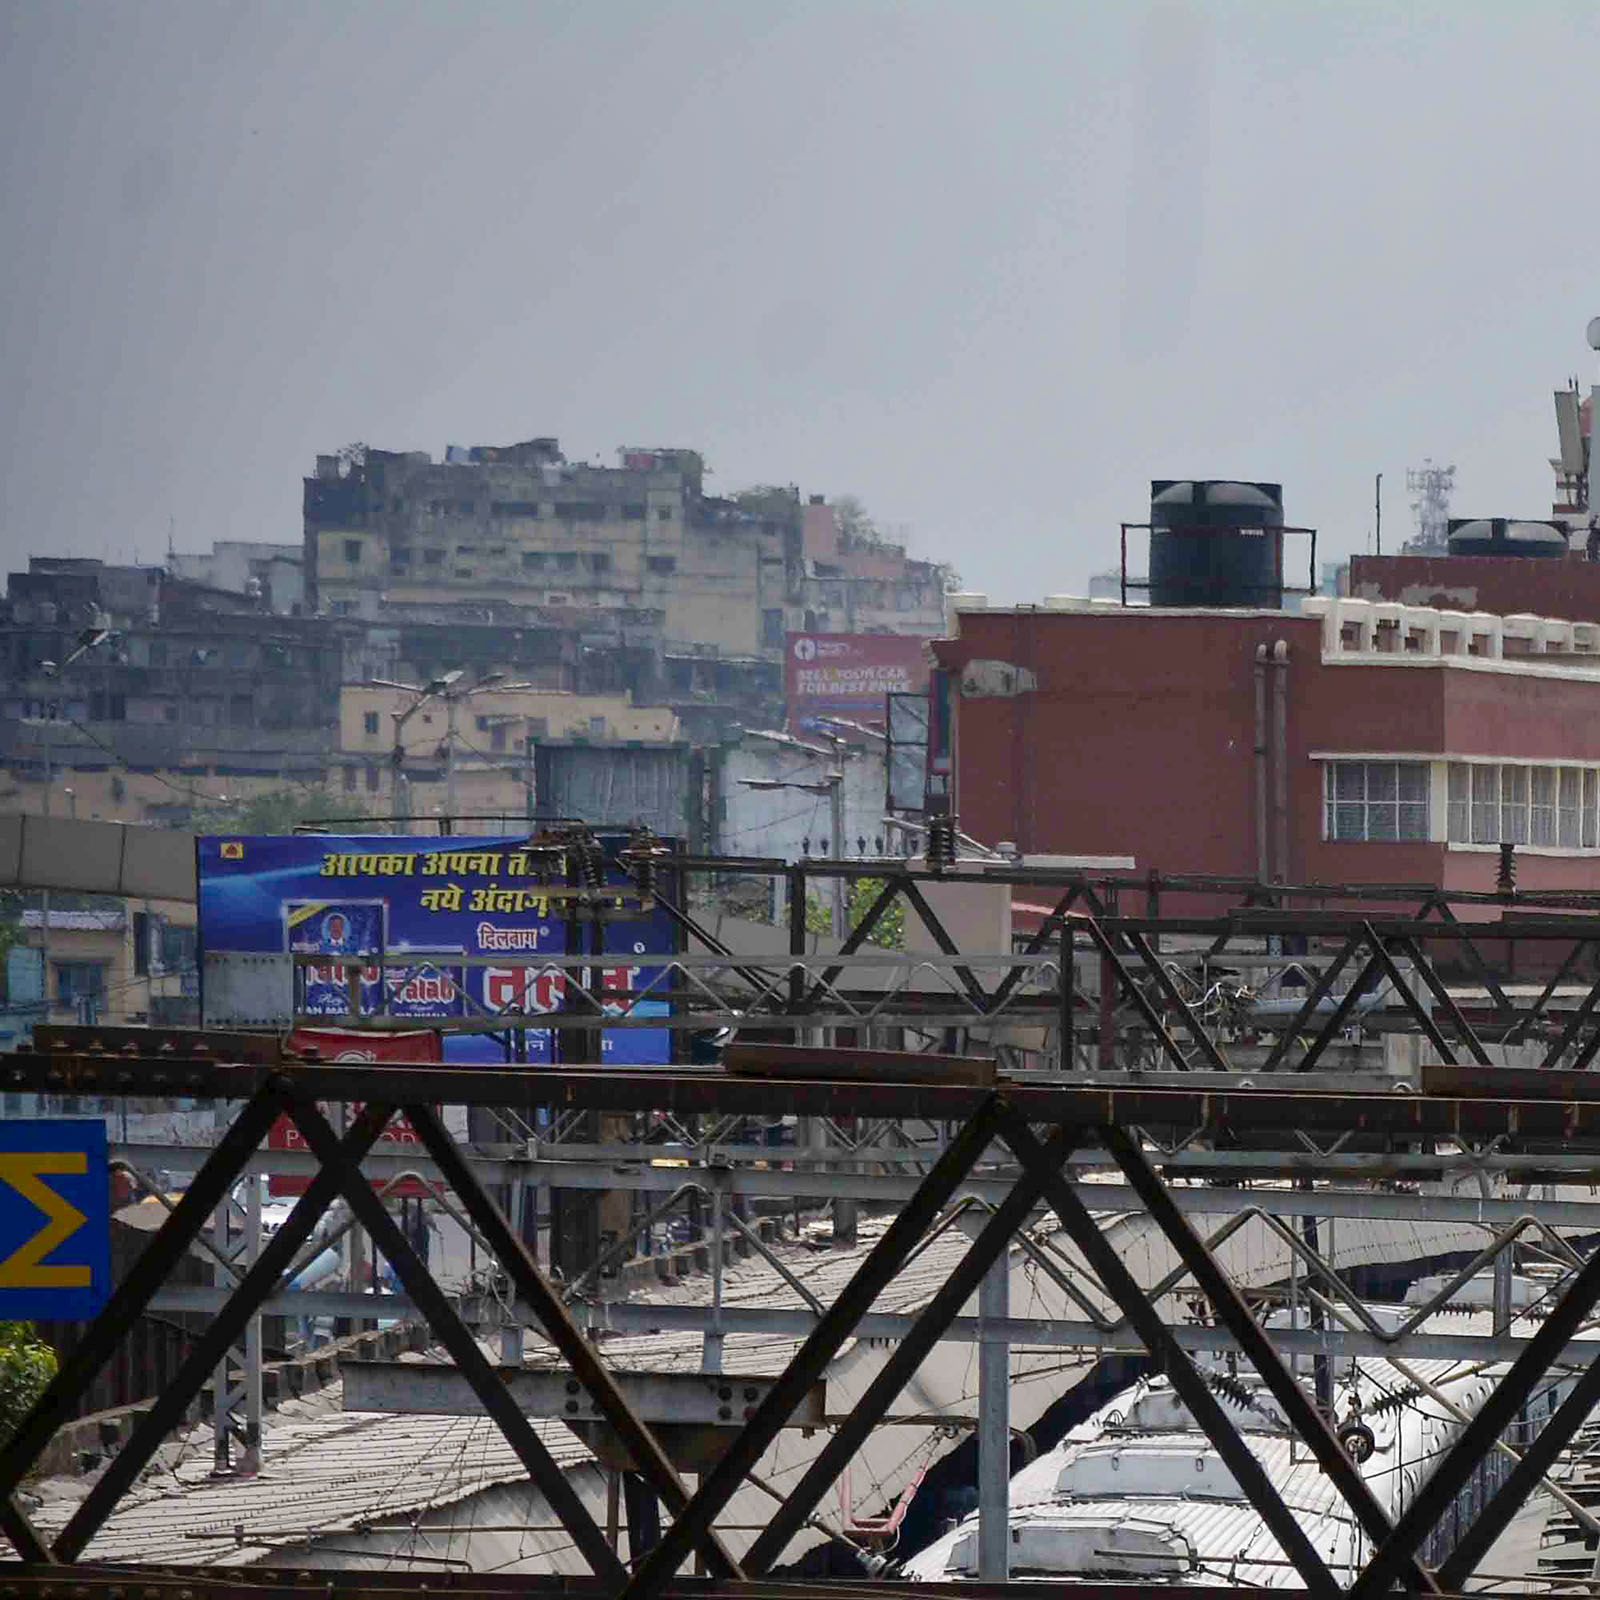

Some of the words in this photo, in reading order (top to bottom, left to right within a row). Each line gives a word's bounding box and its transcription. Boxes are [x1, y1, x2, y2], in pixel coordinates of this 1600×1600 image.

[320, 852, 416, 876] आपका
[421, 852, 502, 876] अपना
[420, 884, 463, 911] नये
[478, 922, 537, 950] दिलबाग
